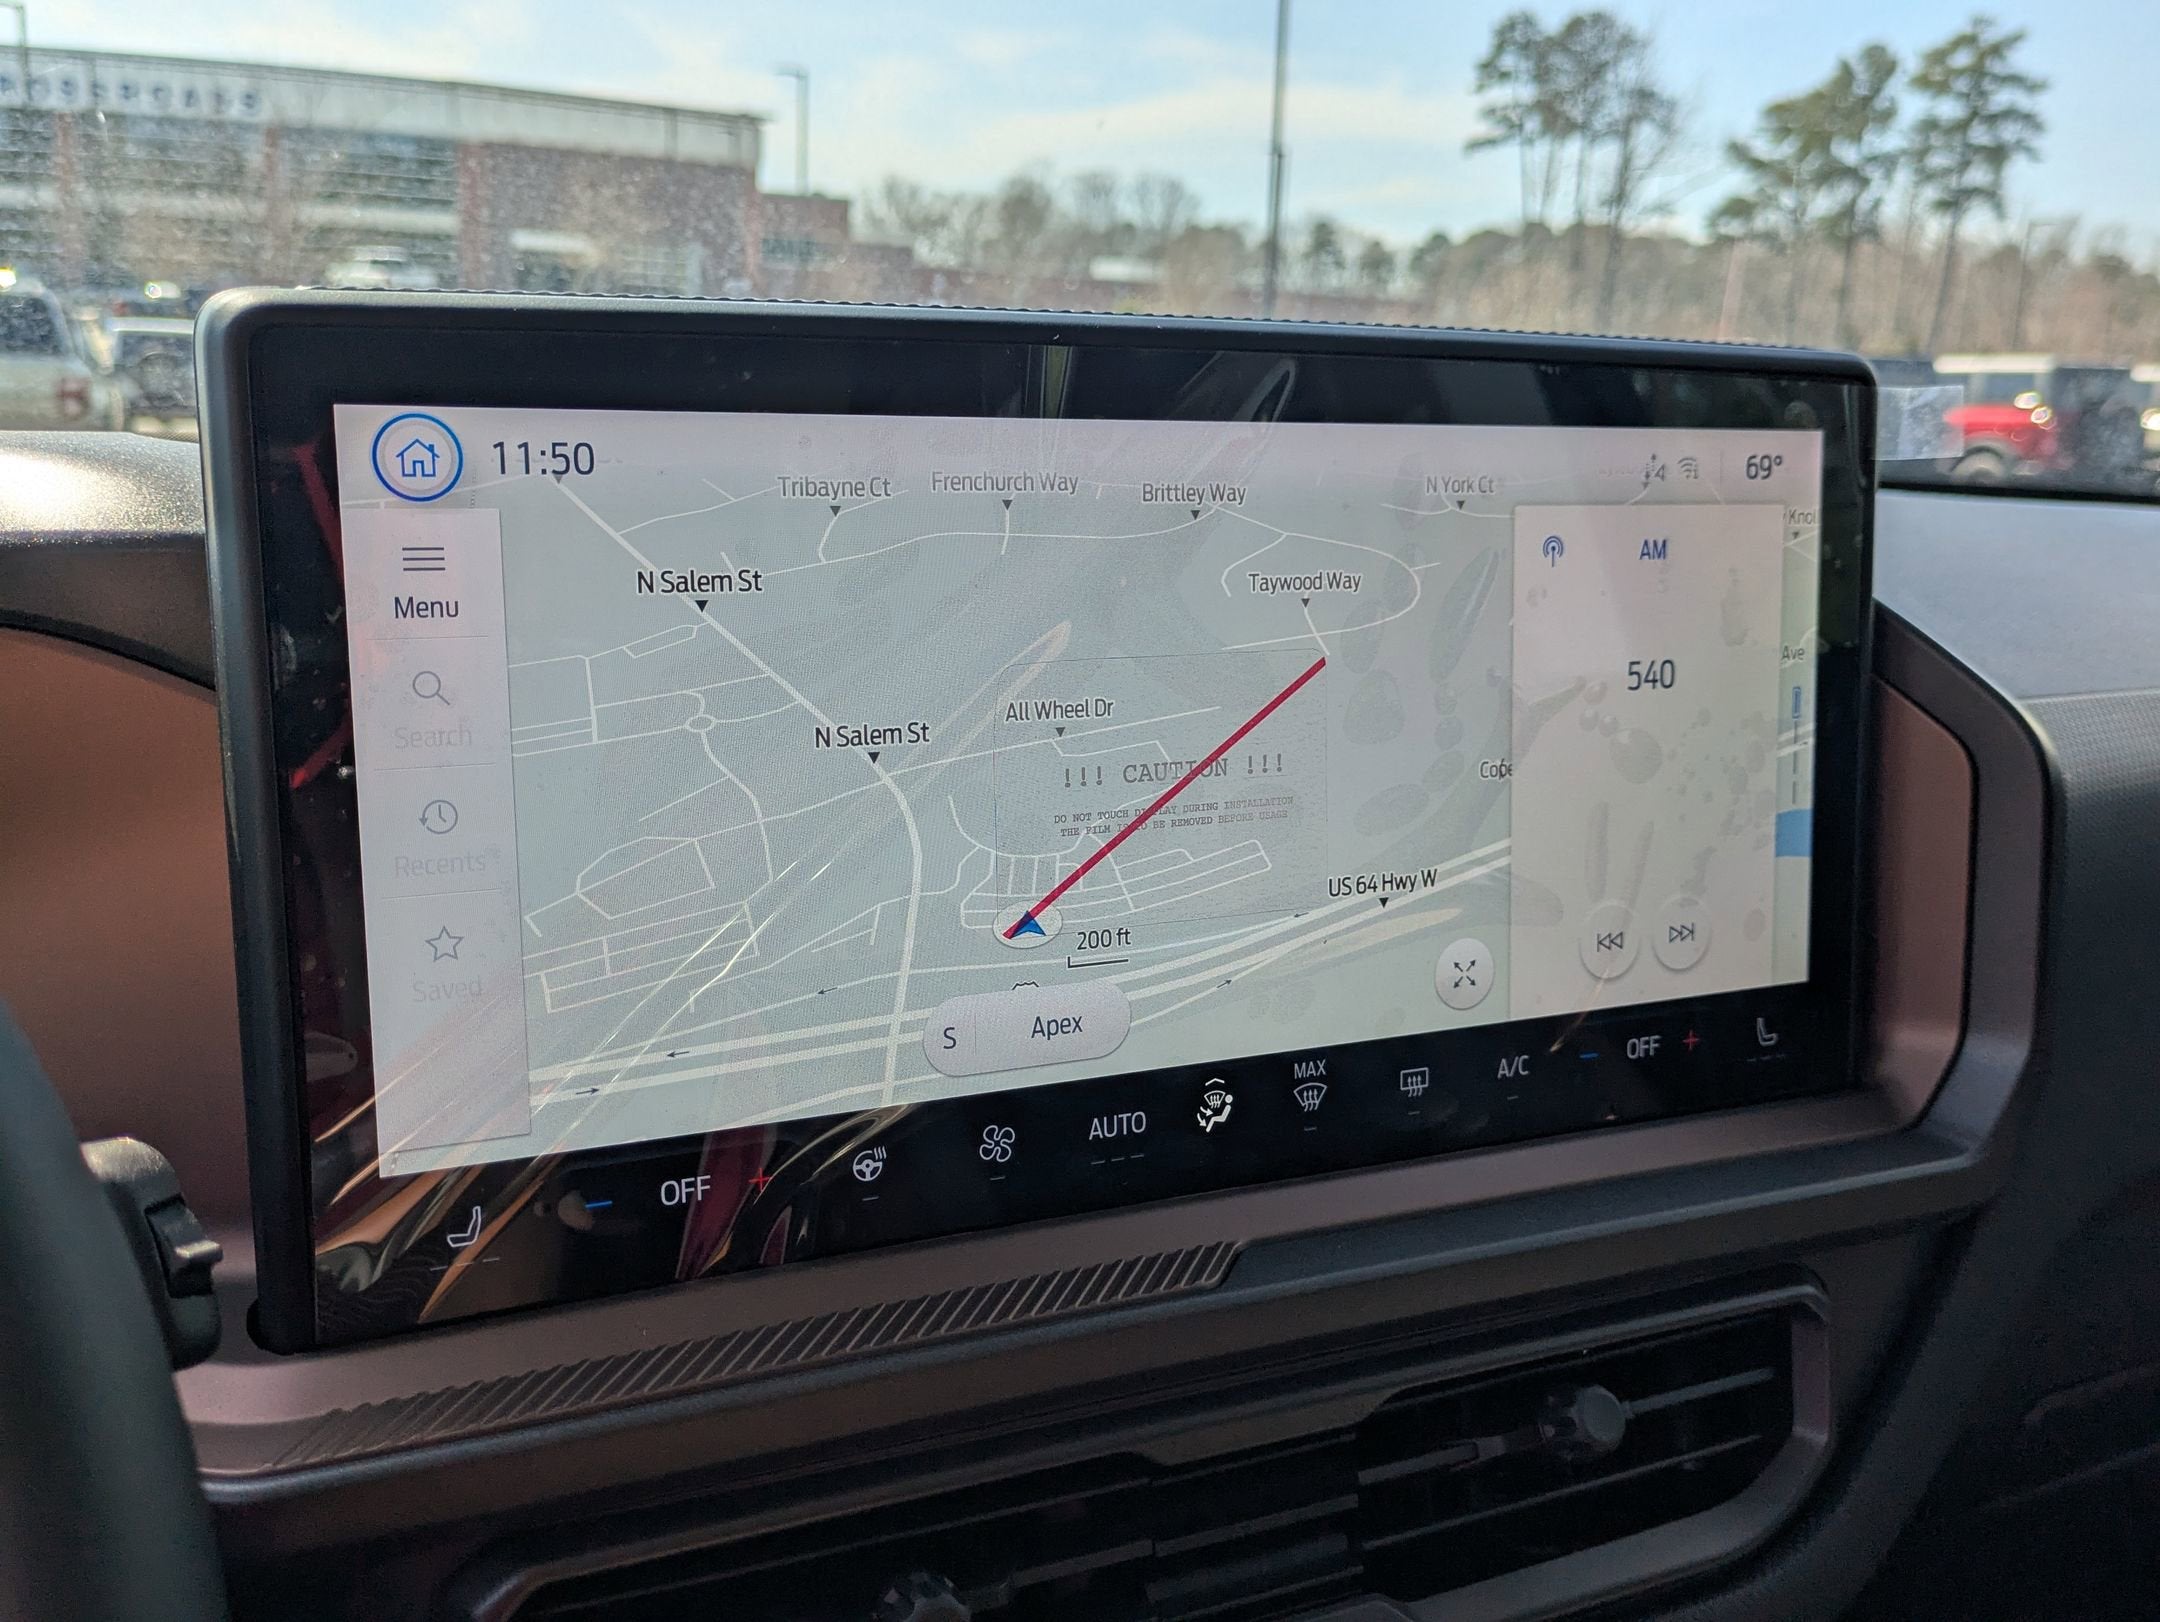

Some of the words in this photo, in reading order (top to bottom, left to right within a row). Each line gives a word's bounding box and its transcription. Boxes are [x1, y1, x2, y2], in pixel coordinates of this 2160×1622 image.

[493, 441, 595, 475] 11:50
[778, 476, 866, 500] Tribayne
[869, 476, 891, 497] Ct
[931, 472, 1034, 492] Frenchurch
[1040, 472, 1079, 495] Way
[1142, 483, 1205, 506] Brittley
[1209, 484, 1246, 505] Way
[1426, 476, 1437, 494] N
[1442, 476, 1474, 494] York
[1478, 476, 1494, 494] Ct
[1639, 539, 1667, 560] AM
[637, 571, 654, 593] N
[660, 570, 733, 592] Salem
[738, 570, 762, 591] St
[1249, 572, 1323, 594] Taywood
[1327, 573, 1361, 593] Way
[394, 597, 459, 619] Menu
[1781, 645, 1805, 660] Ave
[1627, 660, 1675, 690] 540
[1005, 702, 1030, 721] All
[1035, 699, 1090, 720] Wheel
[1095, 699, 1114, 717] Dr
[394, 726, 473, 749] Search
[815, 727, 830, 748] N
[837, 724, 902, 747] Salem
[907, 722, 929, 743] St
[1054, 814, 1067, 824] DO
[1073, 812, 1092, 822] NOT
[1097, 809, 1129, 820] TOUCH
[1183, 802, 1219, 813] DURING
[1224, 796, 1294, 810] INSTALLATION
[1061, 828, 1080, 837] THE
[1086, 824, 1111, 835] FILM
[1153, 820, 1166, 829] BE
[1171, 816, 1213, 828] REMOVED
[1218, 812, 1254, 824] BEFORE
[1259, 809, 1288, 820] USAGE
[395, 852, 487, 877] Recents
[1328, 877, 1351, 897] US
[1356, 875, 1378, 894] 64
[1381, 872, 1418, 892] Hwy
[1421, 869, 1437, 887] W
[1077, 929, 1112, 950] 200
[1116, 928, 1131, 945] ft
[412, 977, 483, 1002] Saved
[943, 1027, 957, 1049] S
[1031, 1016, 1083, 1040] Apex
[1627, 1034, 1661, 1059] OFF
[1294, 1059, 1327, 1079] MAX
[1497, 1055, 1530, 1079] A/C
[1088, 1111, 1147, 1140] AUTO
[660, 1175, 711, 1206] OFF
